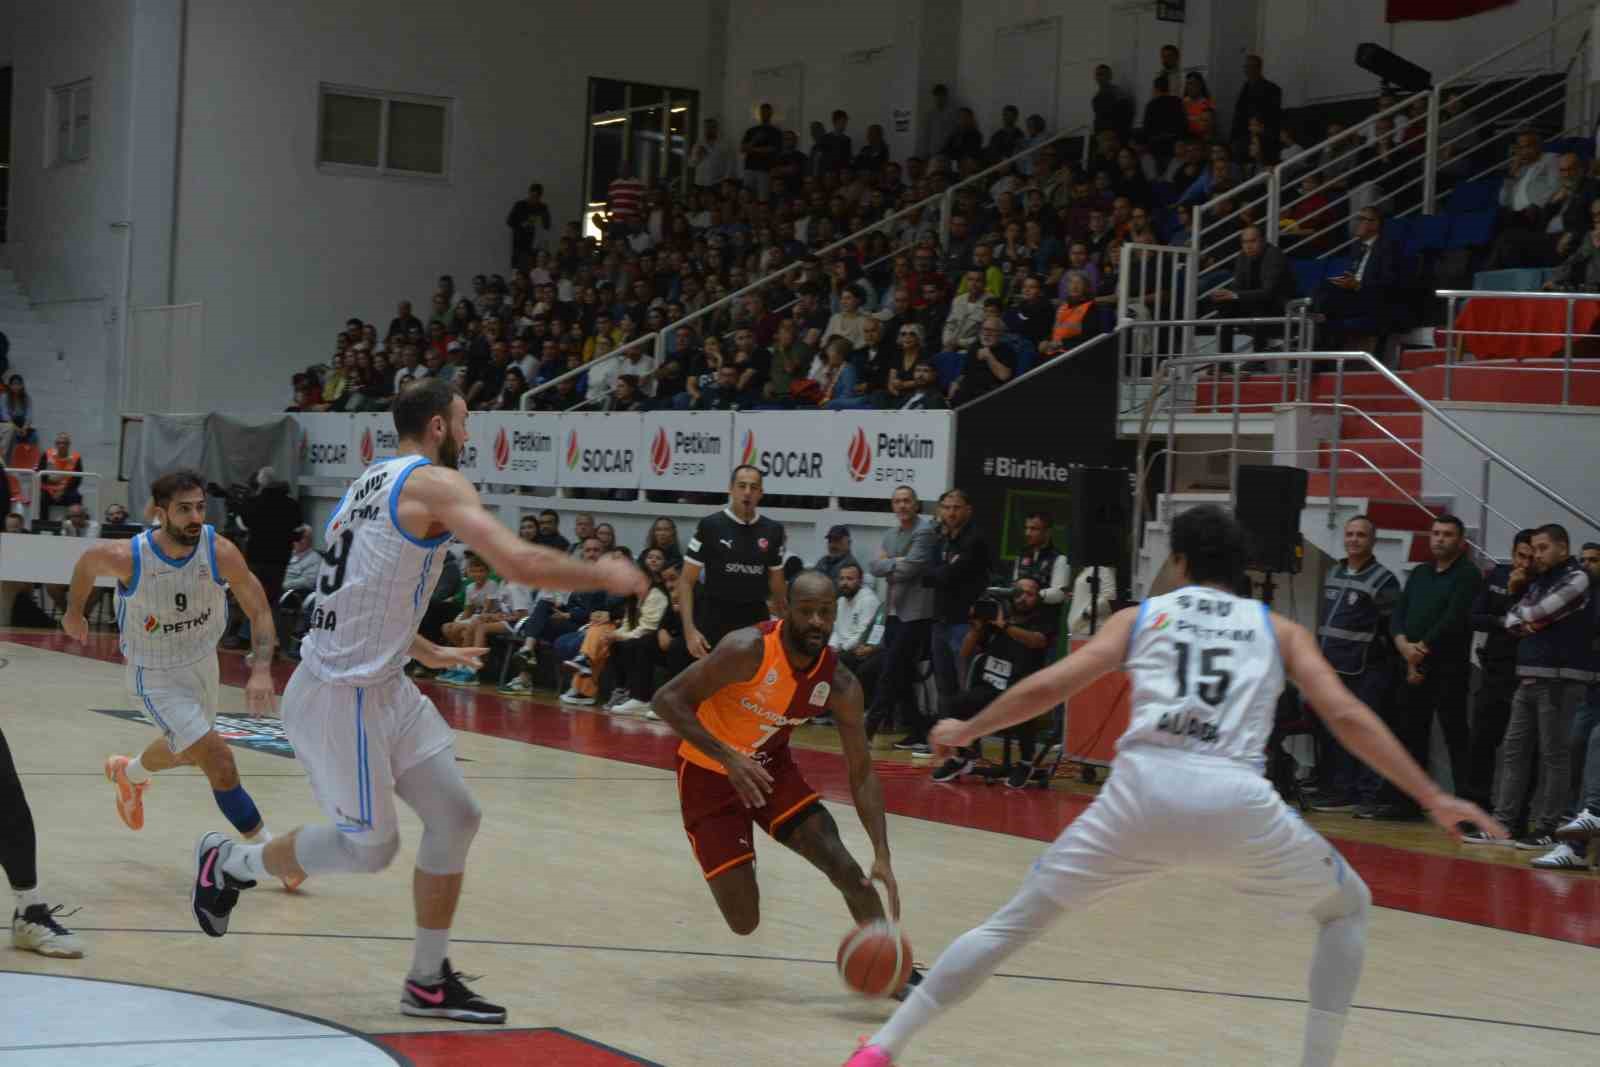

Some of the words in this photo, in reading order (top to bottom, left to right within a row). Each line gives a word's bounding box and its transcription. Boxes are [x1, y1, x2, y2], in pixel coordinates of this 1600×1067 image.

[512, 431, 552, 451] Petkim
[674, 431, 720, 454] Petkim
[877, 433, 934, 459] Petkim
[310, 443, 346, 464] SOCAR
[582, 449, 633, 472] SOCAR
[761, 451, 823, 478] SOCAR
[874, 467, 915, 482] SPOR
[175, 593, 187, 612] 9
[1175, 642, 1233, 705] 15
